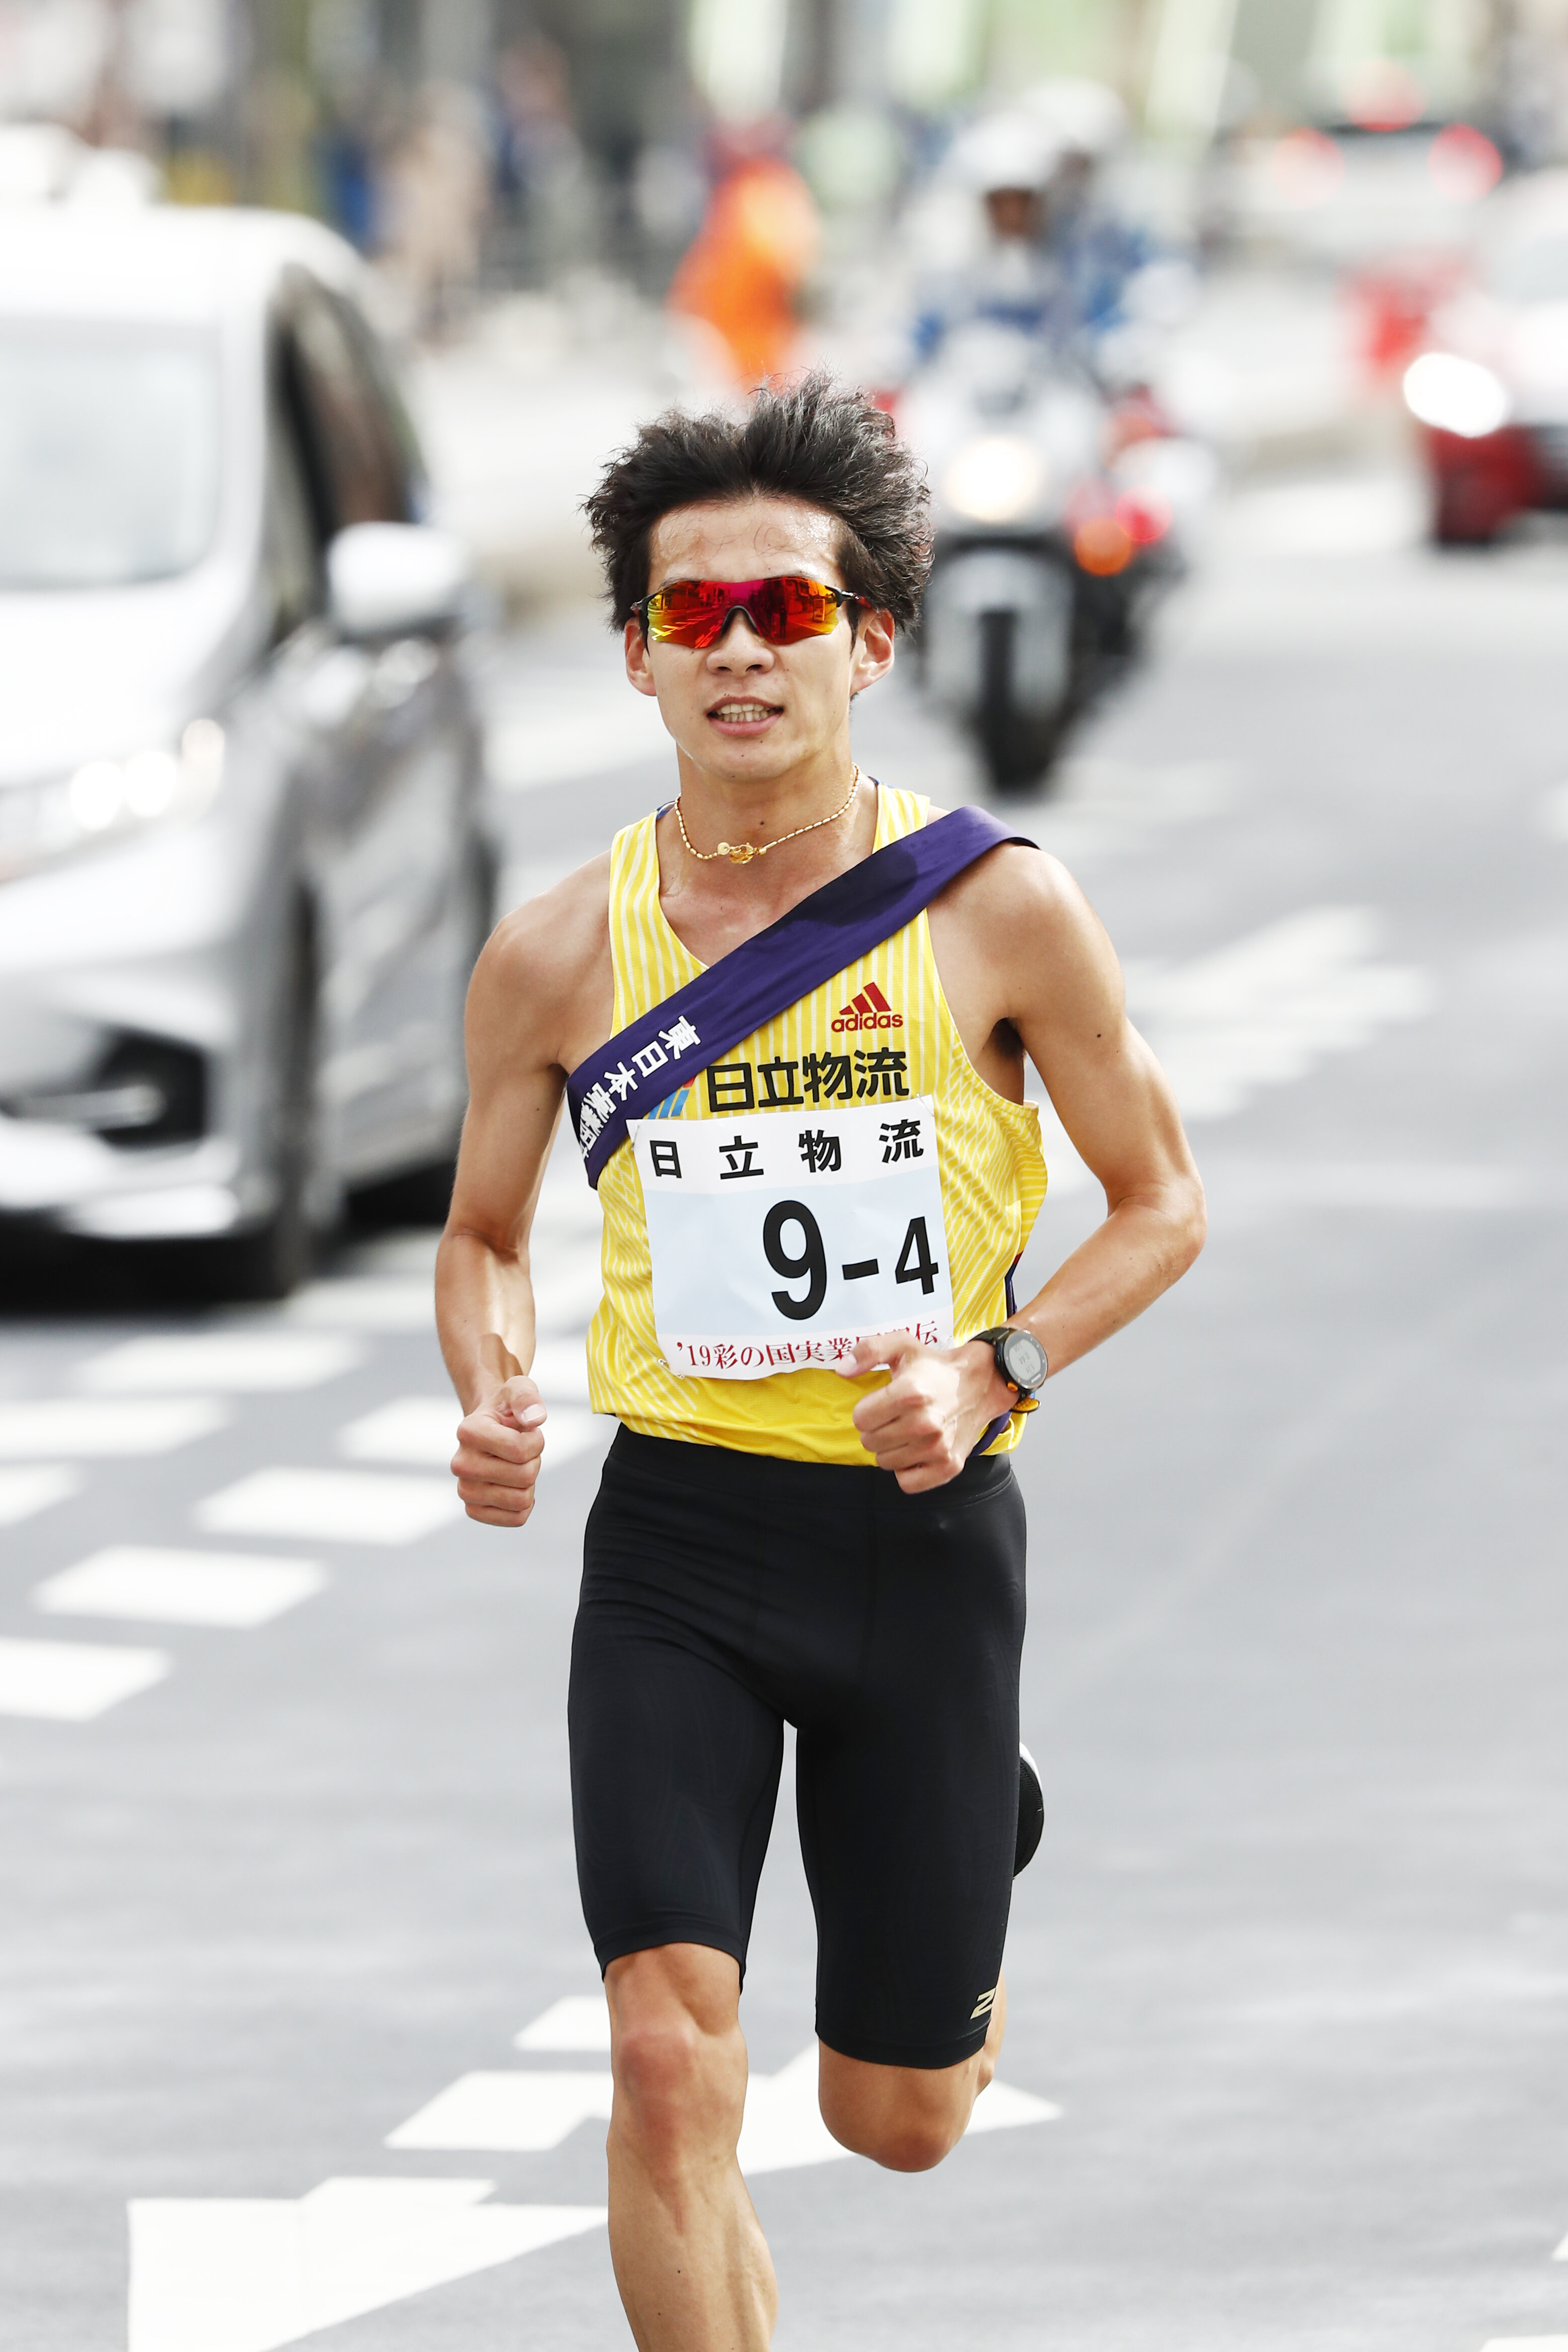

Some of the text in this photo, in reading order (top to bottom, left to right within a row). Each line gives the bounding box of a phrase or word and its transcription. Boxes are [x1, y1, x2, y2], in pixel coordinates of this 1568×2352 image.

[831, 1012, 903, 1032] adidas
[706, 1047, 909, 1112] 日立物流
[763, 1200, 939, 1320] 9-4
